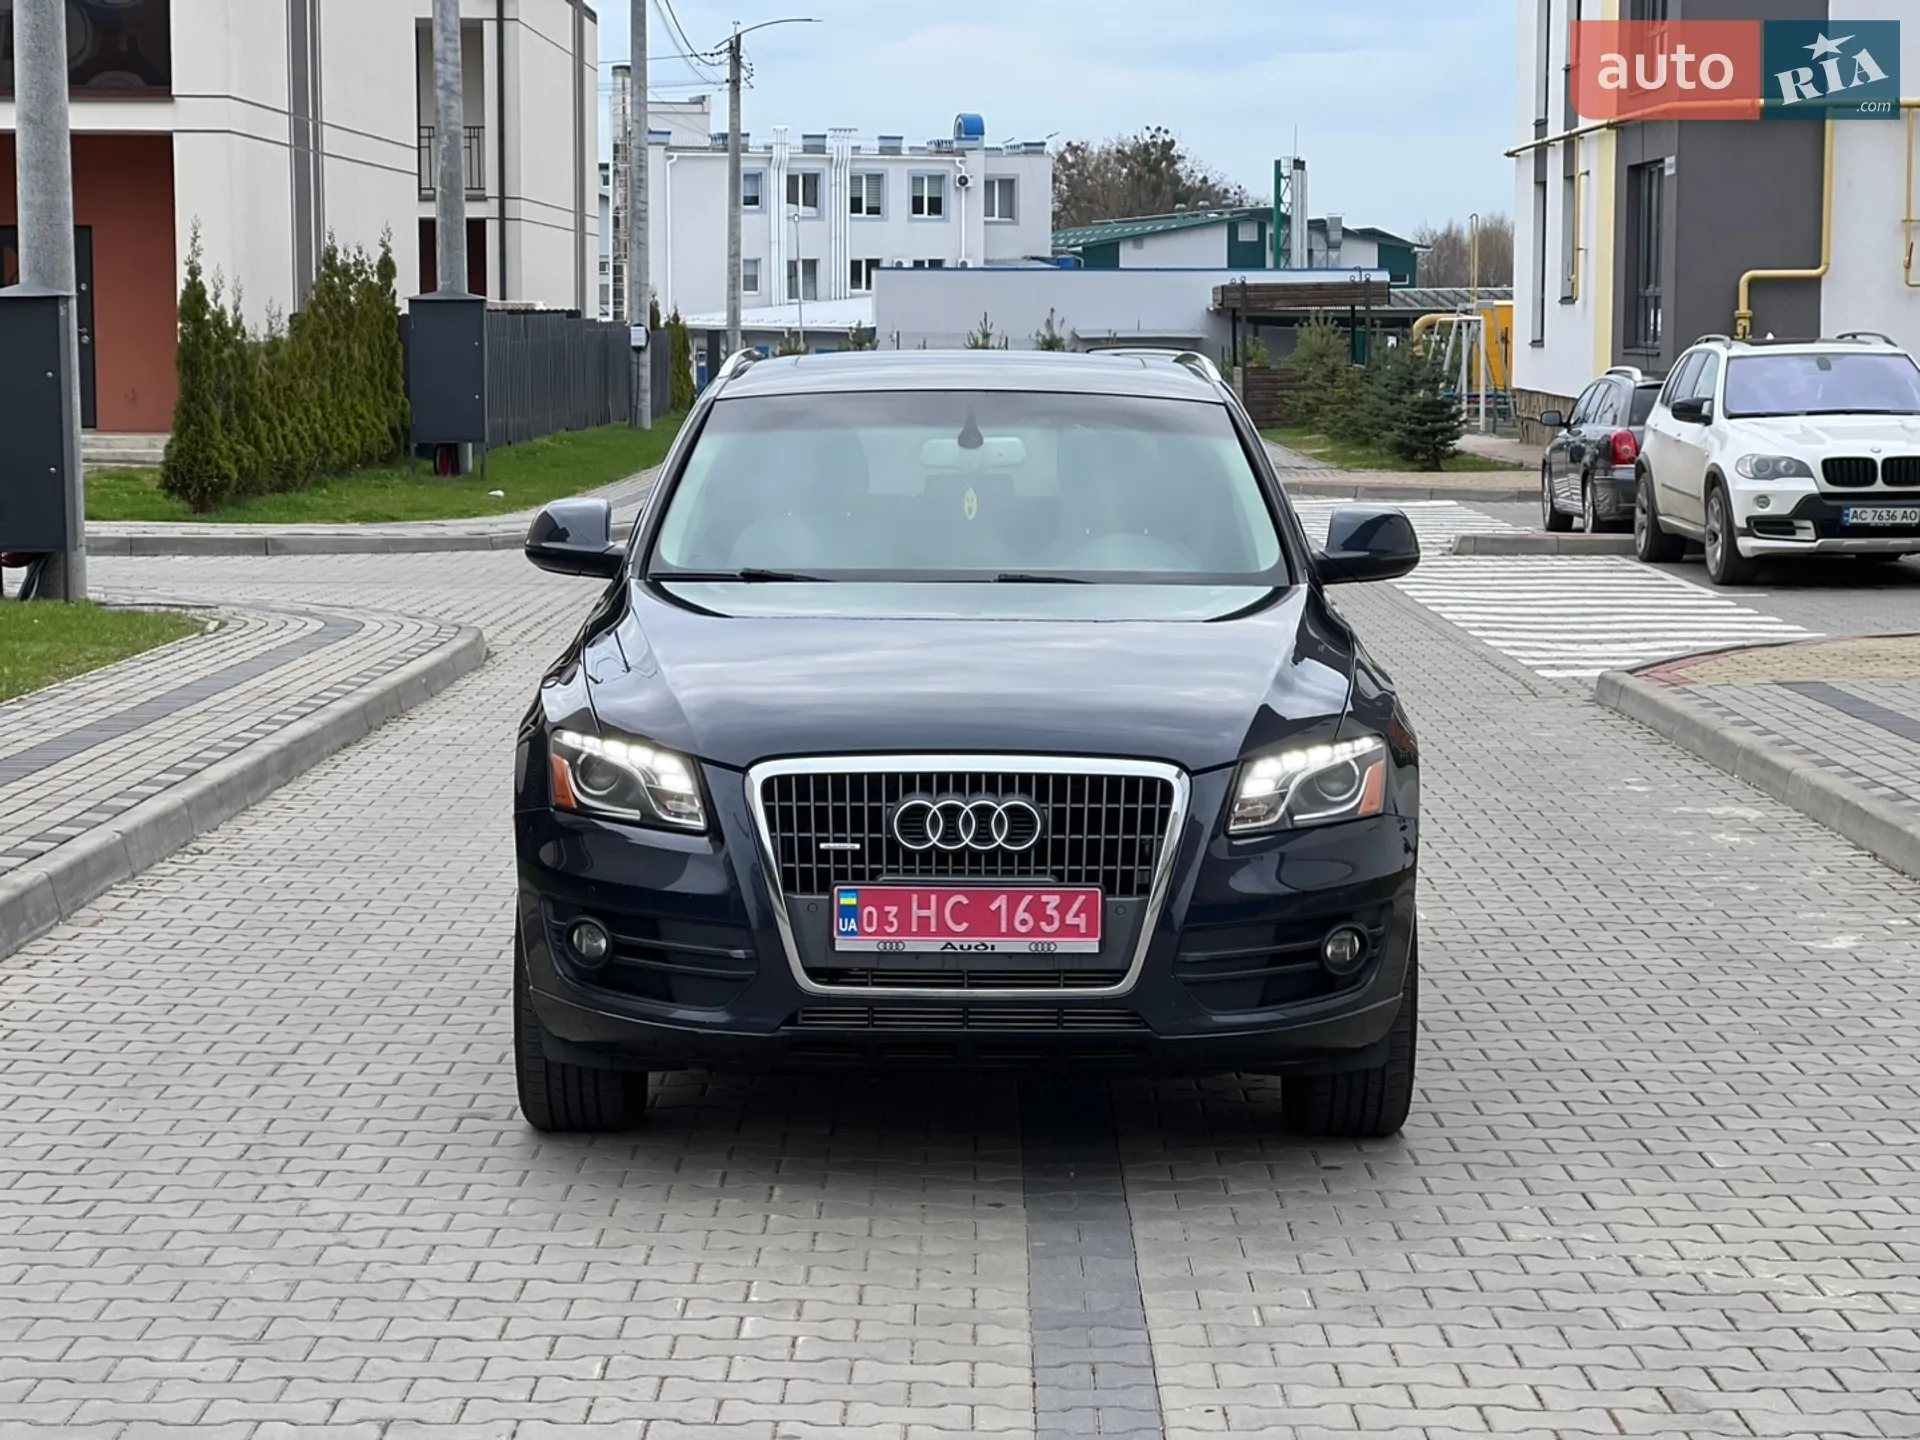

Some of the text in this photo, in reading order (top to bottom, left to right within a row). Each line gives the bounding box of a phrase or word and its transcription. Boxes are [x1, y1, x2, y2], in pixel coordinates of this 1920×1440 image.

[1851, 509, 1868, 521] AC
[1871, 509, 1897, 521] 7636
[862, 893, 1087, 934] 03 HC 1634
[839, 917, 857, 932] UA
[940, 941, 995, 952] Audi
